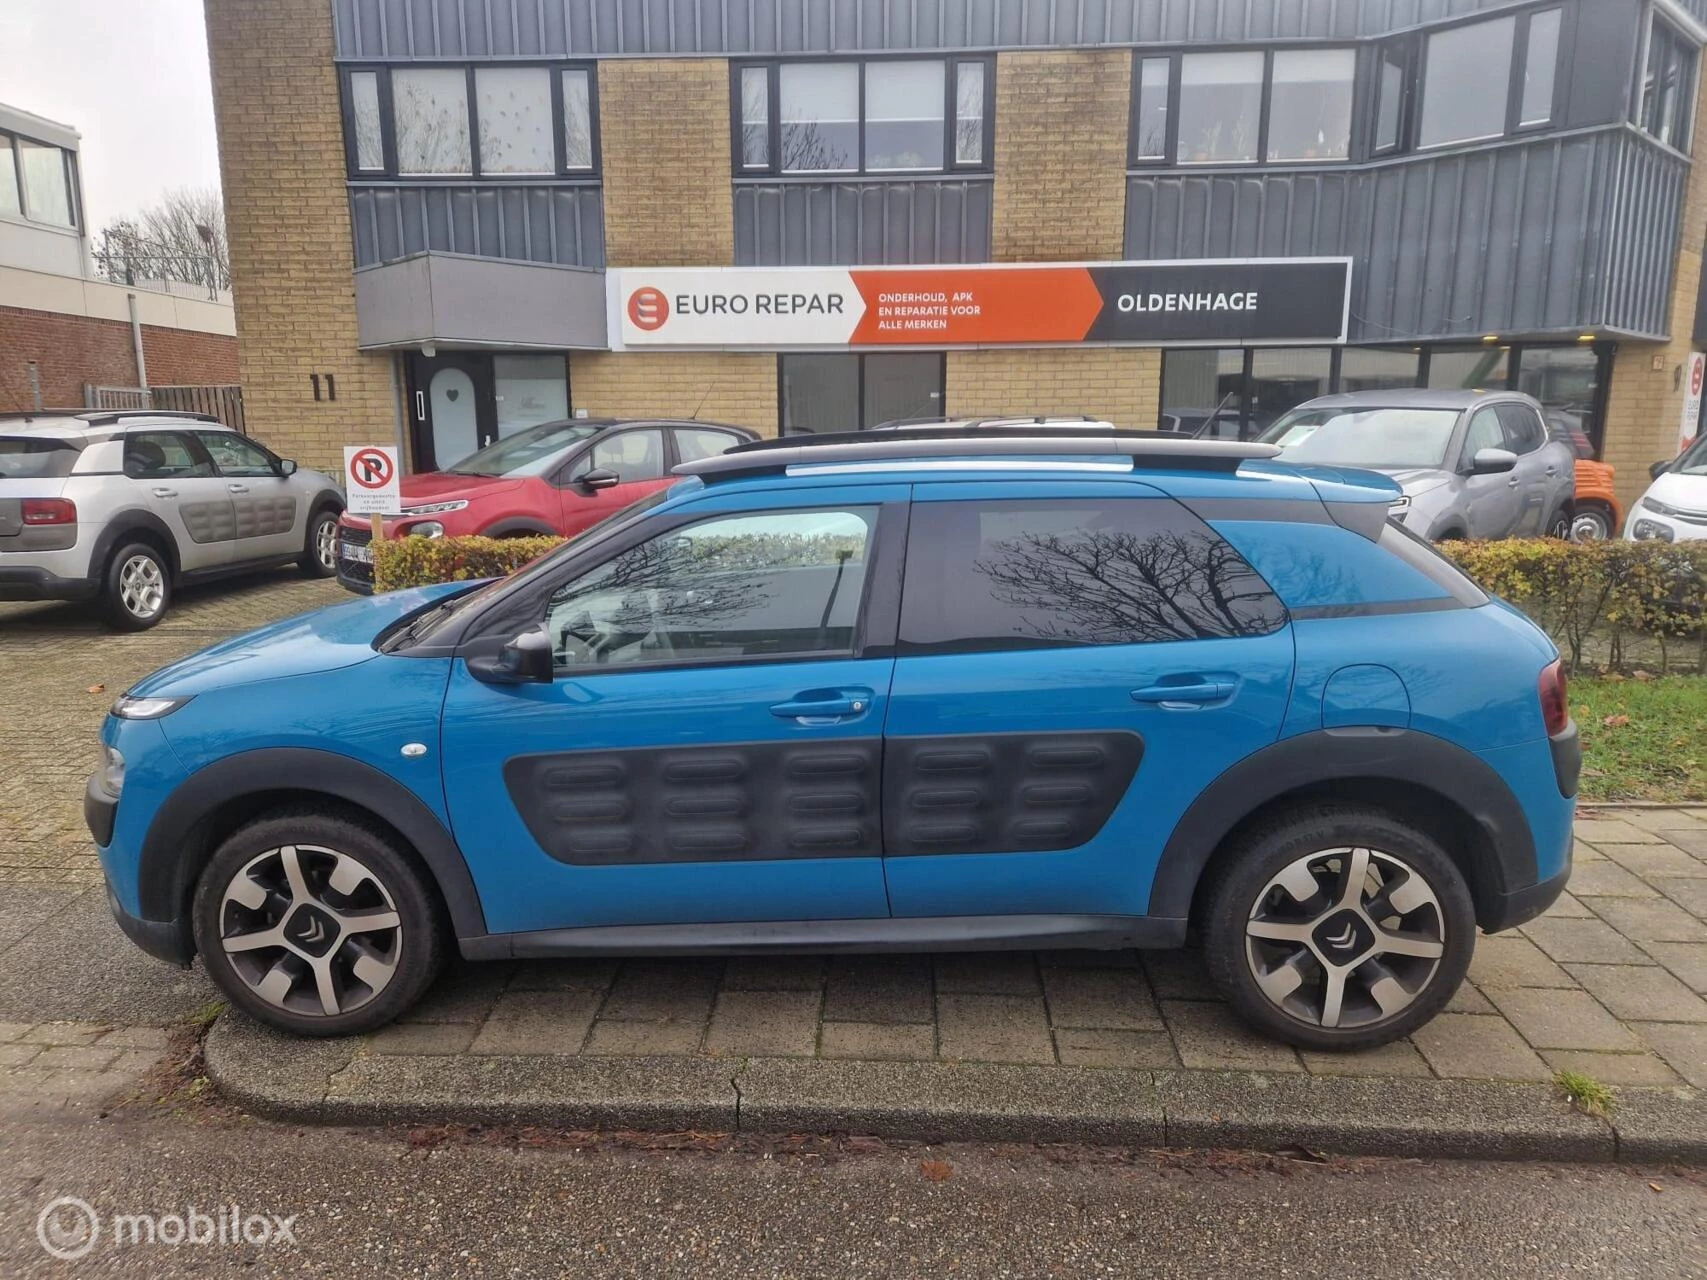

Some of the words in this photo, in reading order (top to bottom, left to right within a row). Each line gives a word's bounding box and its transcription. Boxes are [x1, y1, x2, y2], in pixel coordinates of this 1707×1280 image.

[675, 294, 748, 315] EURO
[755, 293, 844, 315] REPAR
[878, 292, 948, 304] ONDERHOUD,
[951, 291, 974, 303] APK
[1117, 292, 1258, 312] OLDENHAGE
[878, 305, 893, 316] EN
[894, 305, 948, 316] REPARATIE
[949, 304, 981, 316] VOOR
[878, 319, 903, 329] ALLE
[904, 319, 947, 329] MERKEN
[310, 373, 336, 401] 11
